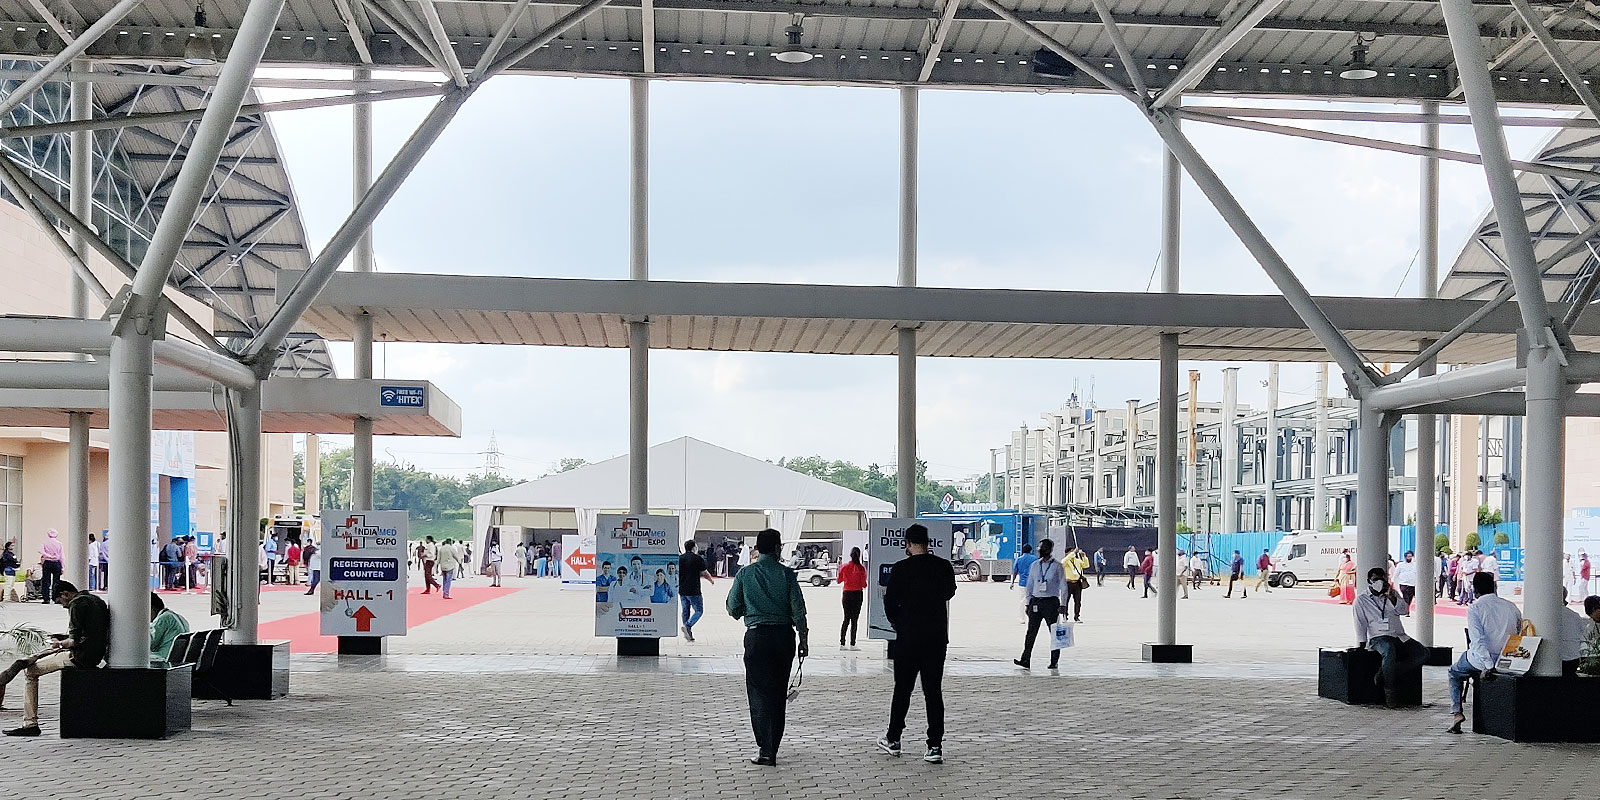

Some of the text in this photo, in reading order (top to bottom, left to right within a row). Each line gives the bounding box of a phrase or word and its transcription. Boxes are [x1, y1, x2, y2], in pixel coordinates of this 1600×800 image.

[884, 527, 906, 537] Indi
[376, 538, 396, 546] EXPO
[880, 537, 944, 549] Diagtic
[1320, 547, 1358, 555] AMBULC
[334, 589, 374, 601] HALL
